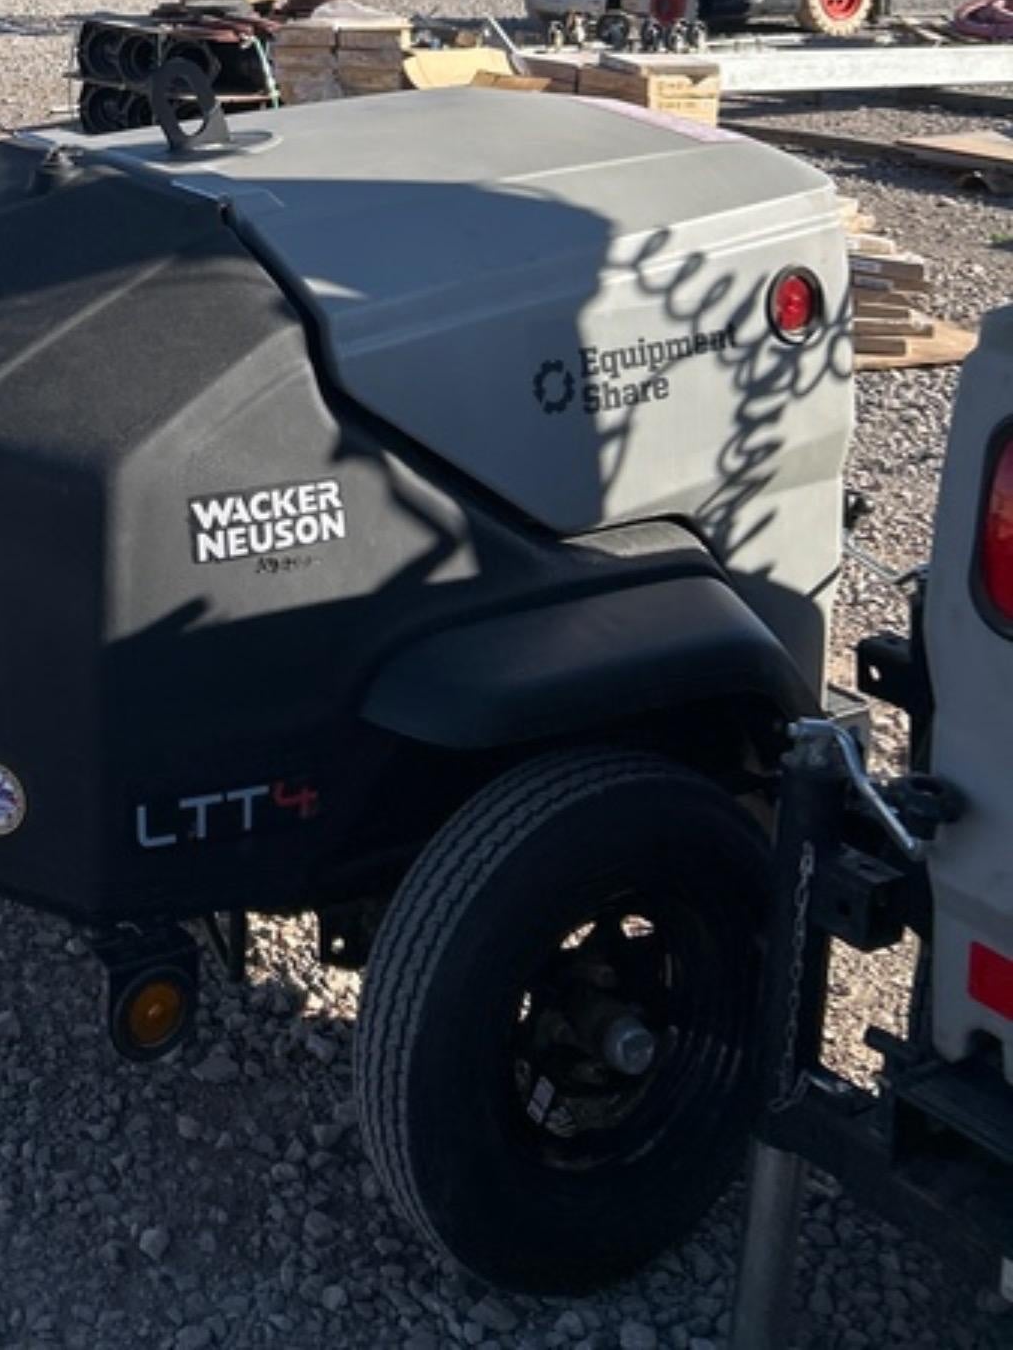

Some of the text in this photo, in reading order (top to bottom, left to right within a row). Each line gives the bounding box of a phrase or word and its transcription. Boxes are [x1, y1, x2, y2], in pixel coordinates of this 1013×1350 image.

[577, 322, 737, 379] Equipment
[581, 376, 670, 414] Share
[190, 479, 343, 530] WACKER
[196, 509, 346, 563] NEUSON
